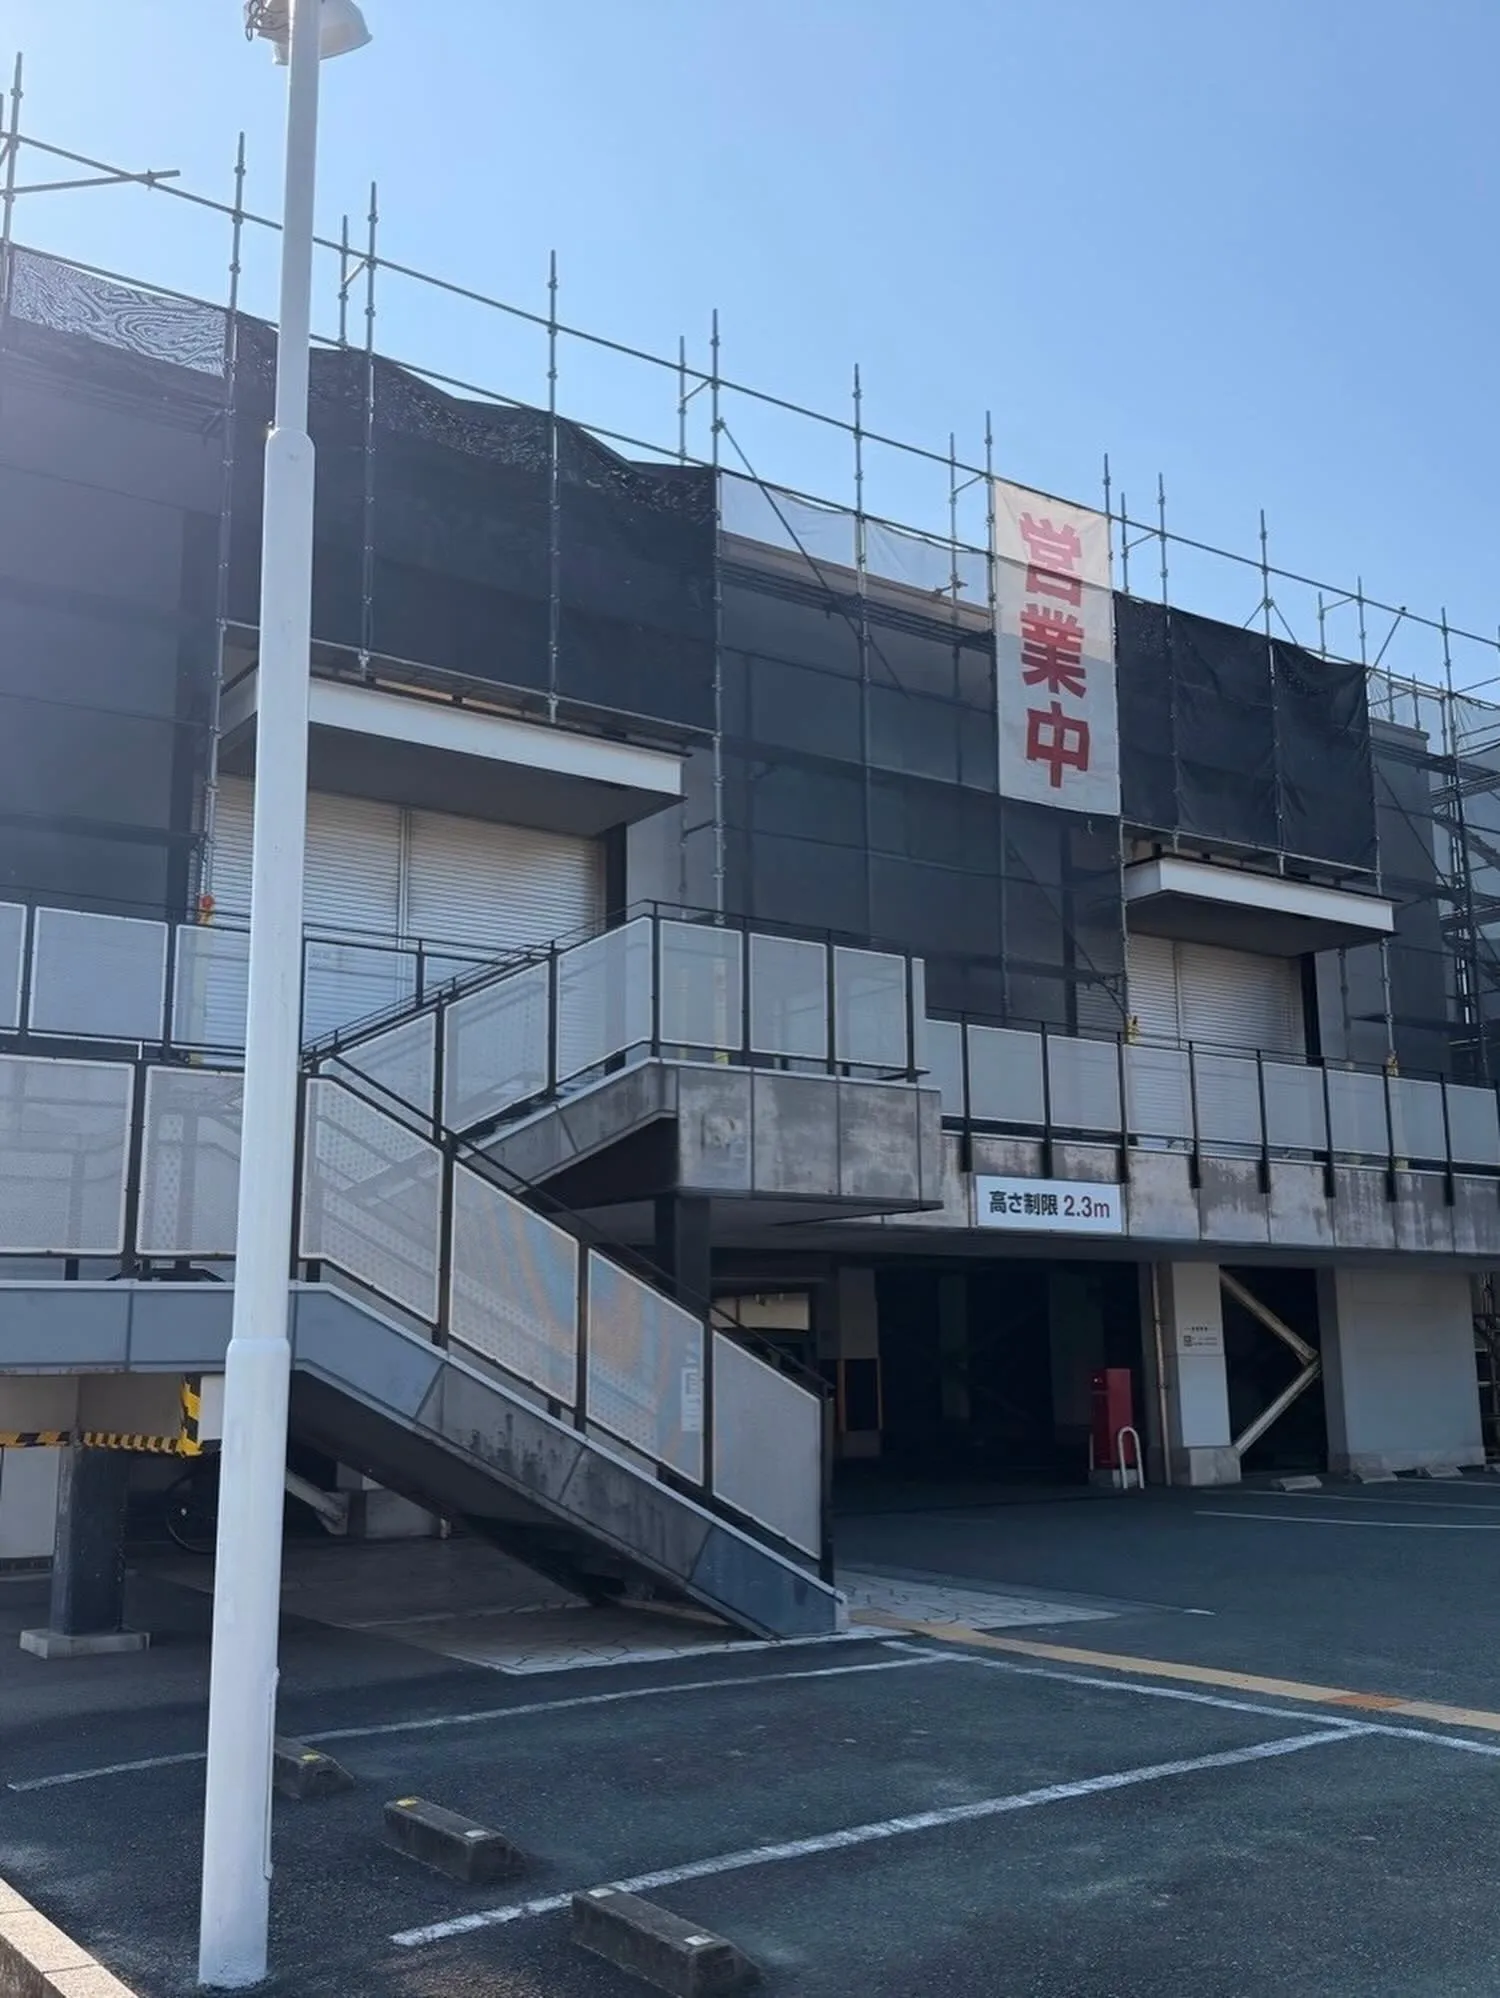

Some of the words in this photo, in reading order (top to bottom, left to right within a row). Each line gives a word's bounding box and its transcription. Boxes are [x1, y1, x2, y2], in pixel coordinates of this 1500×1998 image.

[1019, 511, 1090, 789] 営業中
[989, 1190, 1059, 1216] 高さ制限
[1063, 1194, 1110, 1219] 2.3m
